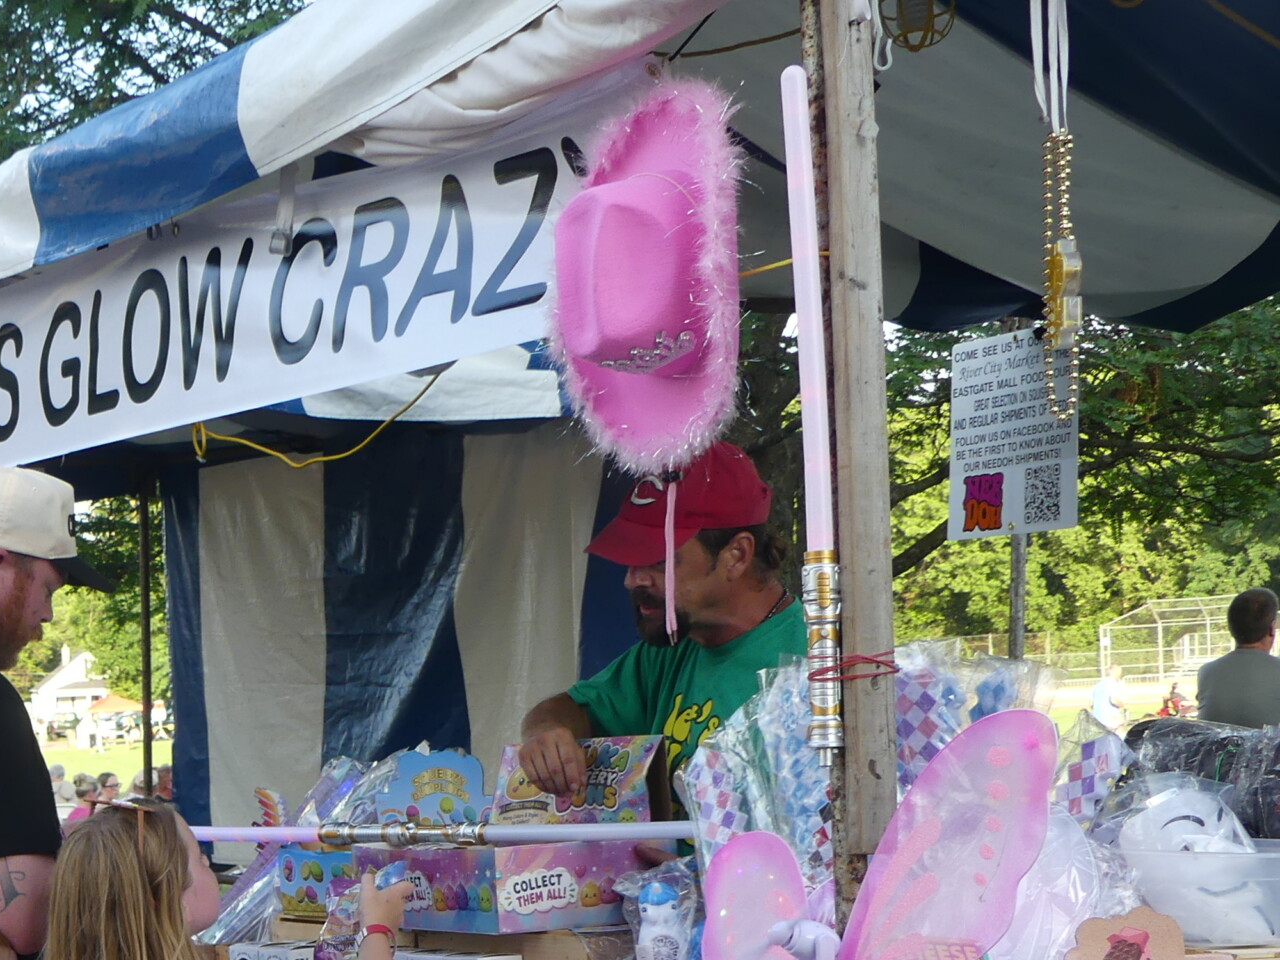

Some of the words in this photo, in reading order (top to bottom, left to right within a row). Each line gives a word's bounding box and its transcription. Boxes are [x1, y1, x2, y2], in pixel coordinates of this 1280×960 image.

[39, 237, 254, 428] GLOW
[269, 135, 588, 366] CRAZ
[954, 348, 979, 363] COME
[982, 344, 998, 358] SEE
[1001, 341, 1012, 354] US
[1015, 338, 1025, 350] AT
[958, 366, 982, 382] River
[984, 361, 1002, 378] City
[1004, 351, 1040, 372] Market
[952, 381, 994, 399] EASTGATE
[997, 377, 1018, 390] MALL
[1021, 371, 1045, 385] FOOD
[953, 418, 967, 431] AND
[968, 412, 999, 428] REGULAR
[1001, 405, 1036, 423] SHIPMENTS
[1038, 403, 1048, 416] OF
[955, 434, 986, 448] FOLLOW
[988, 431, 999, 443] US
[1001, 429, 1012, 441] ON
[1013, 421, 1054, 437] FACEBOOK
[1055, 418, 1073, 430] AND
[956, 450, 966, 461] BE
[968, 448, 984, 459] THE
[984, 443, 1006, 457] FIRST
[1007, 442, 1018, 453] TO
[1020, 437, 1043, 450] KNOW
[1044, 432, 1072, 446] ABOUT
[963, 461, 980, 473] OUR
[981, 456, 1014, 470] NEEDOH
[1015, 448, 1061, 465] SHIPMENTS!
[963, 498, 1003, 532] DOH
[513, 873, 563, 894] COLLECT
[516, 893, 544, 908] THEM
[546, 886, 568, 901] ALL!
